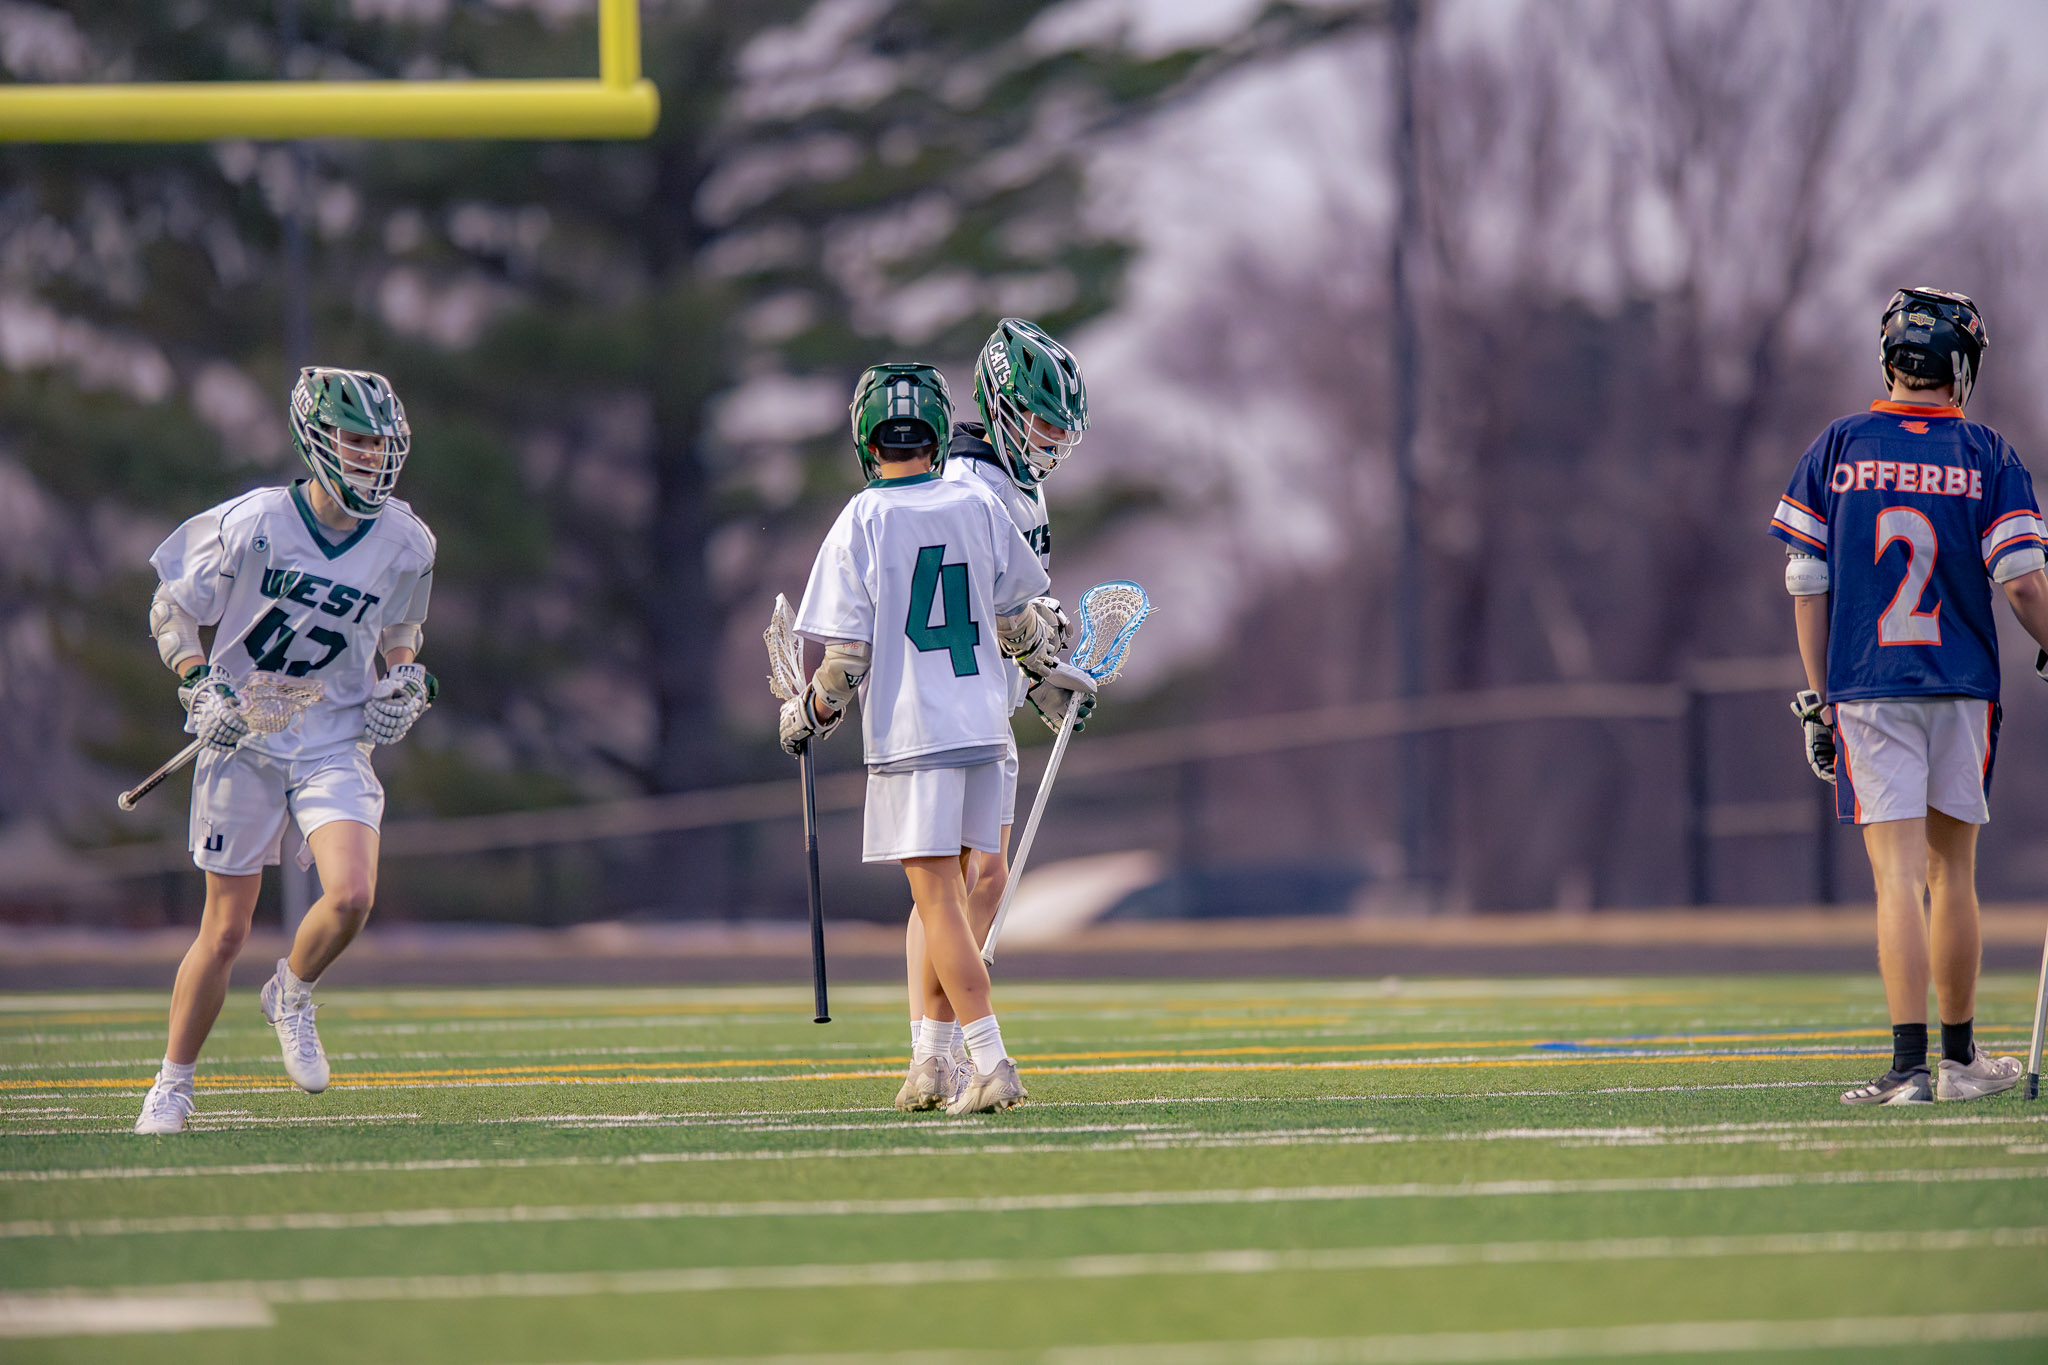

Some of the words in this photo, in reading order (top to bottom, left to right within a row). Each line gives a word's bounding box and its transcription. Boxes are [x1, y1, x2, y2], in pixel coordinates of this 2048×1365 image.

[990, 341, 1012, 385] CATS
[1831, 460, 1983, 500] OFFERBE
[260, 566, 380, 624] WEST
[1875, 506, 1942, 646] 2
[905, 544, 980, 677] 4
